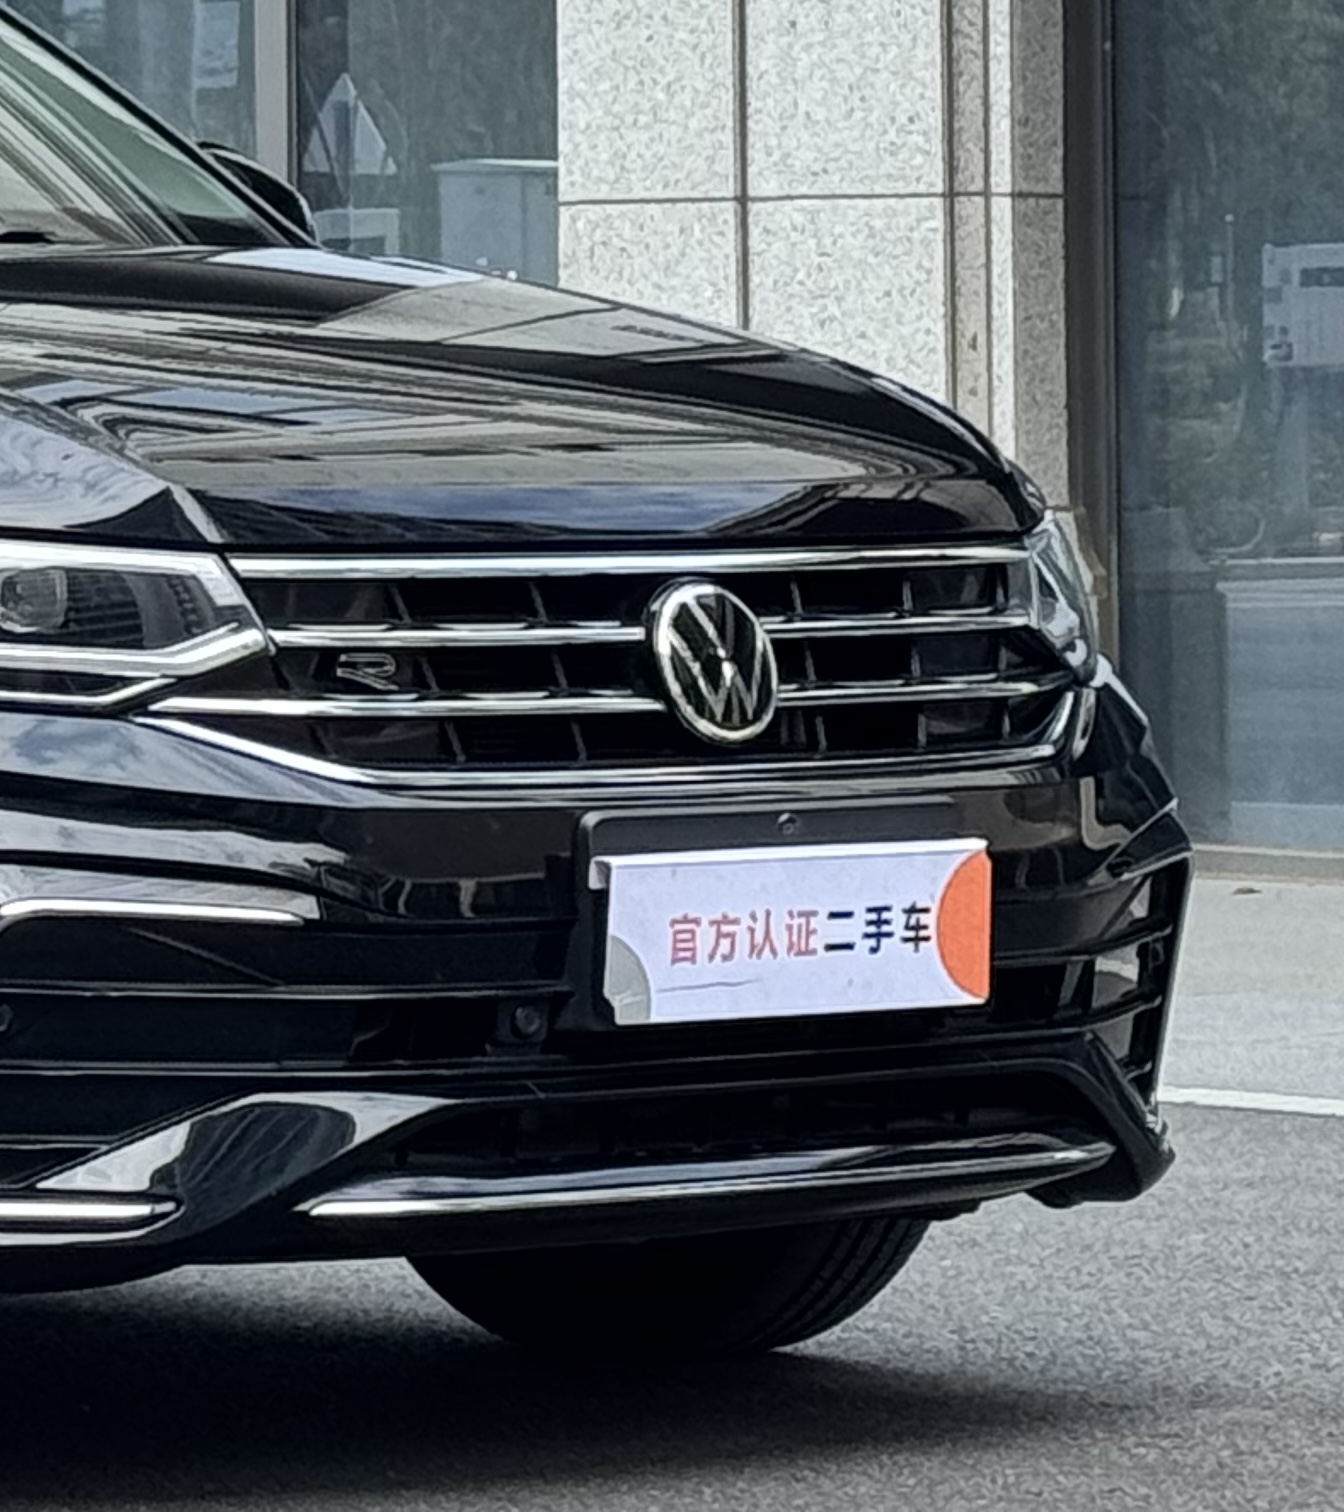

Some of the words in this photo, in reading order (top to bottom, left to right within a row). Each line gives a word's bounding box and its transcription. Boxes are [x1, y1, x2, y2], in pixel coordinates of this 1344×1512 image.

[668, 901, 932, 967] 官方认证二手车
